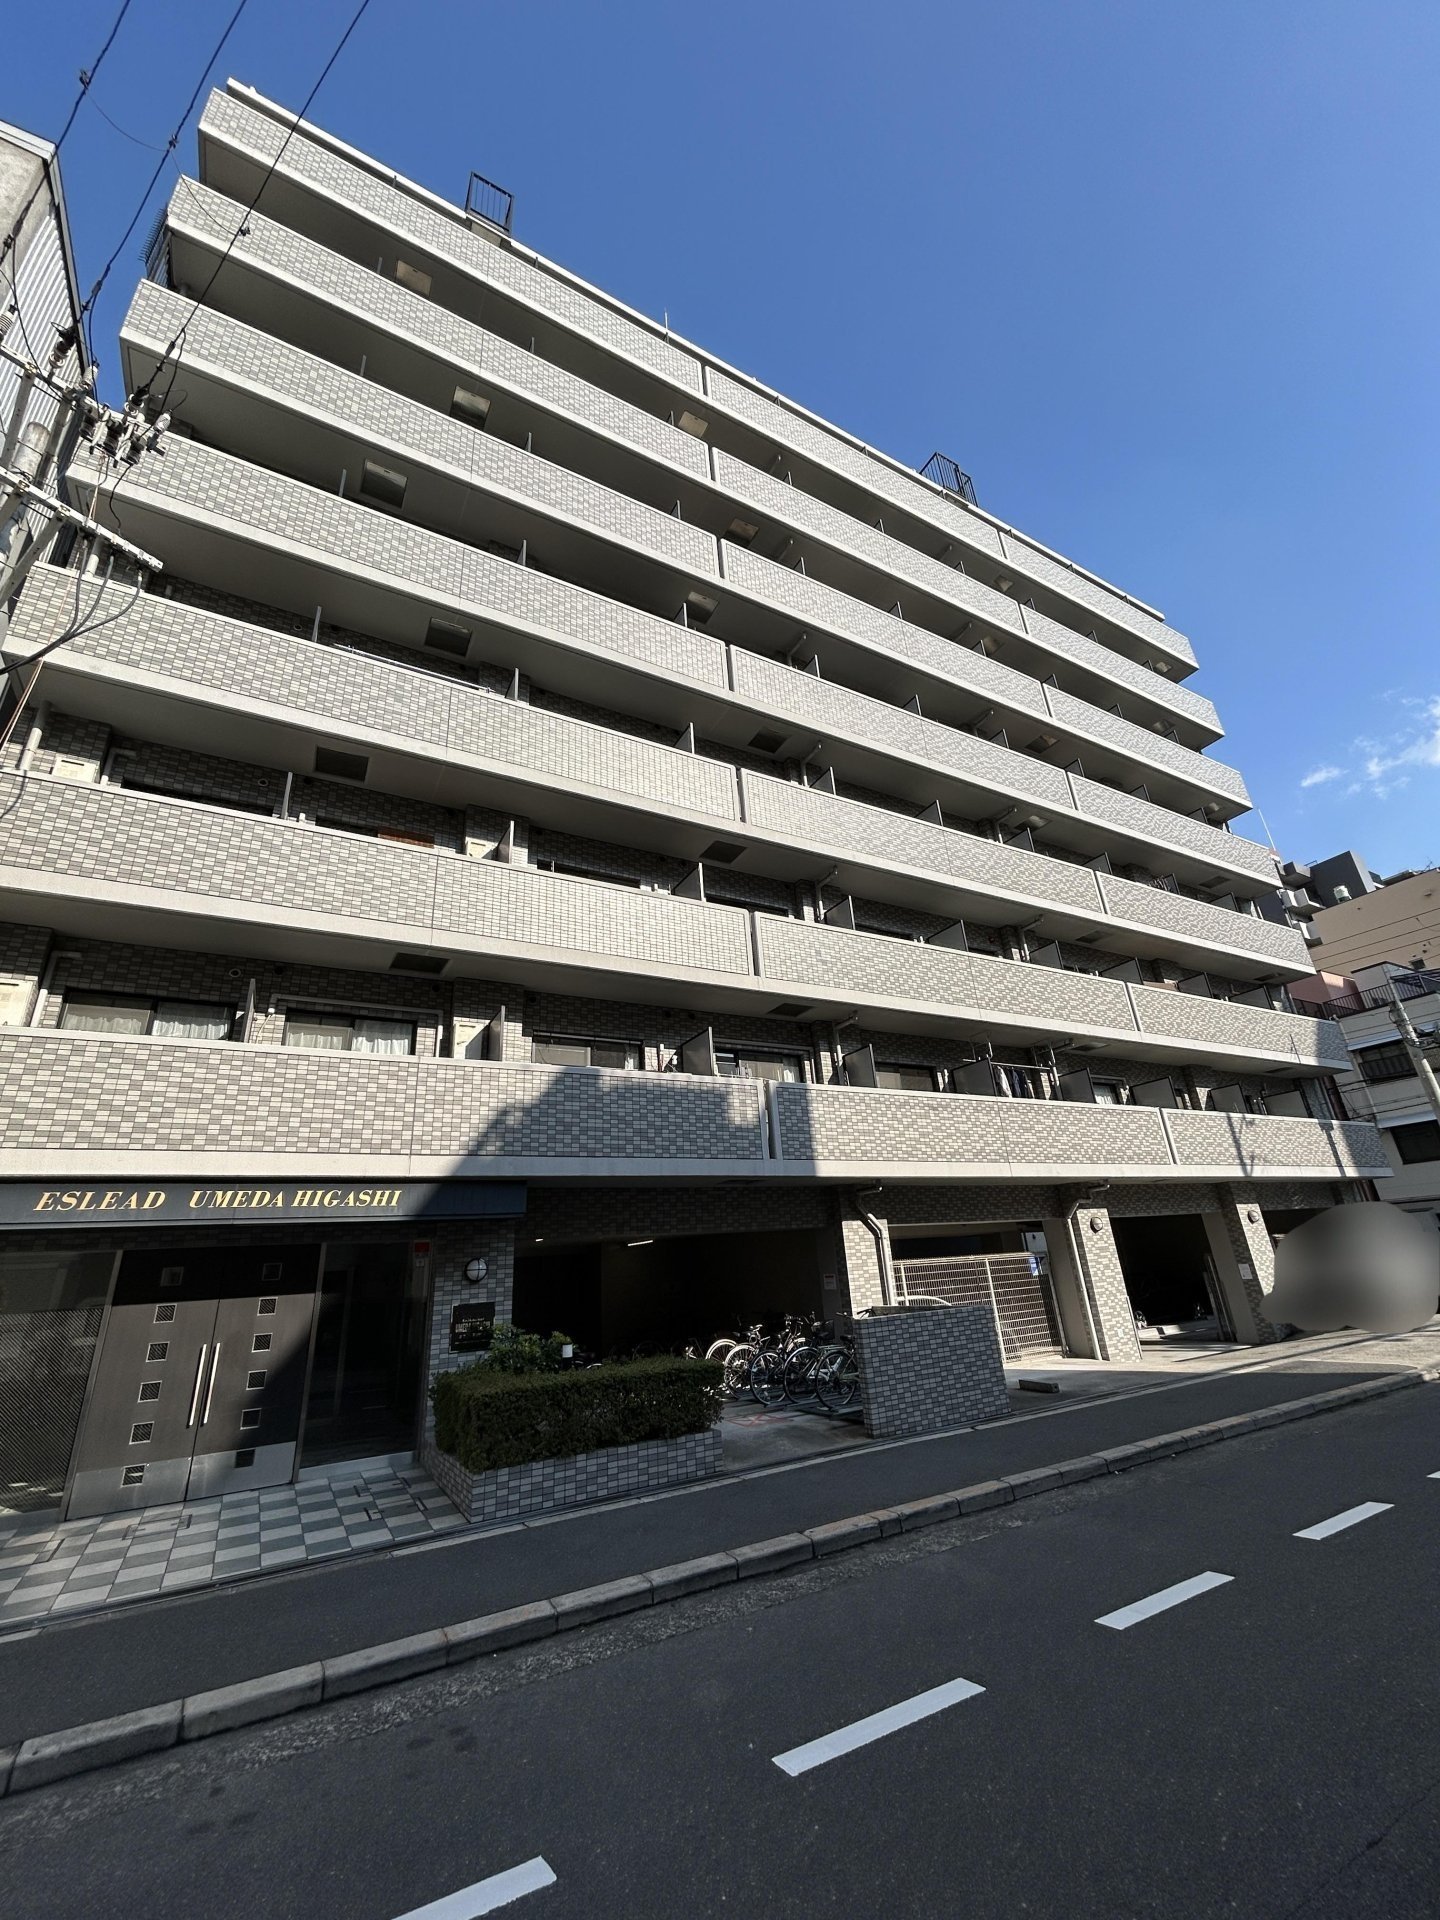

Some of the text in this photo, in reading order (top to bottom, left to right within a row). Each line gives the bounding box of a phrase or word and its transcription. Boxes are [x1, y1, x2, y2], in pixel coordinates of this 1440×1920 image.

[33, 1190, 402, 1211] ESLEAD UMEDA HIGASHI
